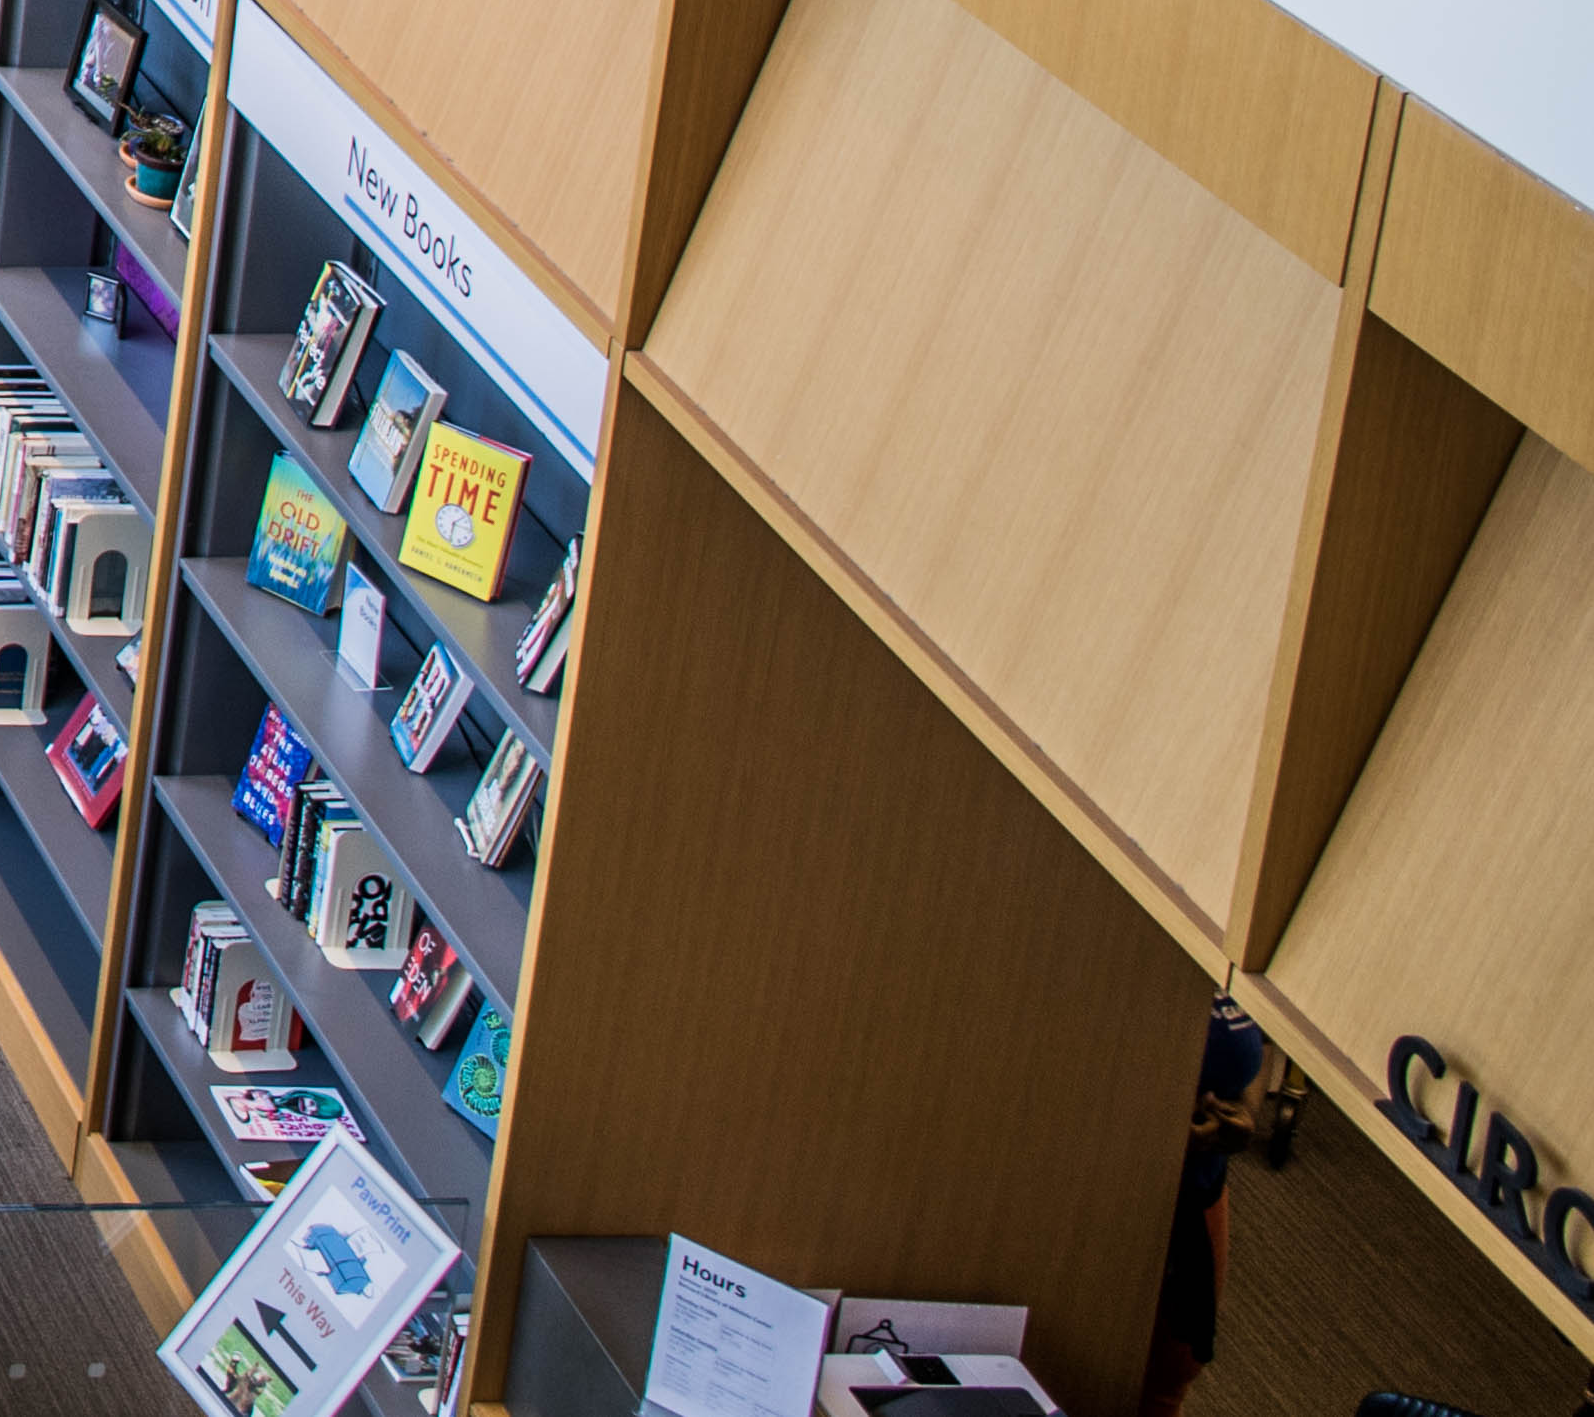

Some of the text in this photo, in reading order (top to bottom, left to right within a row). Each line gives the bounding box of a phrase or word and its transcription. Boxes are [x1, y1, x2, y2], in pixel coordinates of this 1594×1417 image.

[348, 134, 473, 298] New Books
[433, 444, 507, 489] SPENDING
[296, 489, 315, 504] THE
[427, 463, 501, 526] TIME
[280, 500, 321, 532] OLD
[268, 521, 321, 559] DRIFT
[260, 743, 292, 777] ATLAS
[273, 730, 294, 755] THE
[242, 790, 275, 826] BLUES
[351, 1176, 412, 1245] PawPrint
[682, 1254, 747, 1298] Hours
[278, 1267, 336, 1339] This Way
